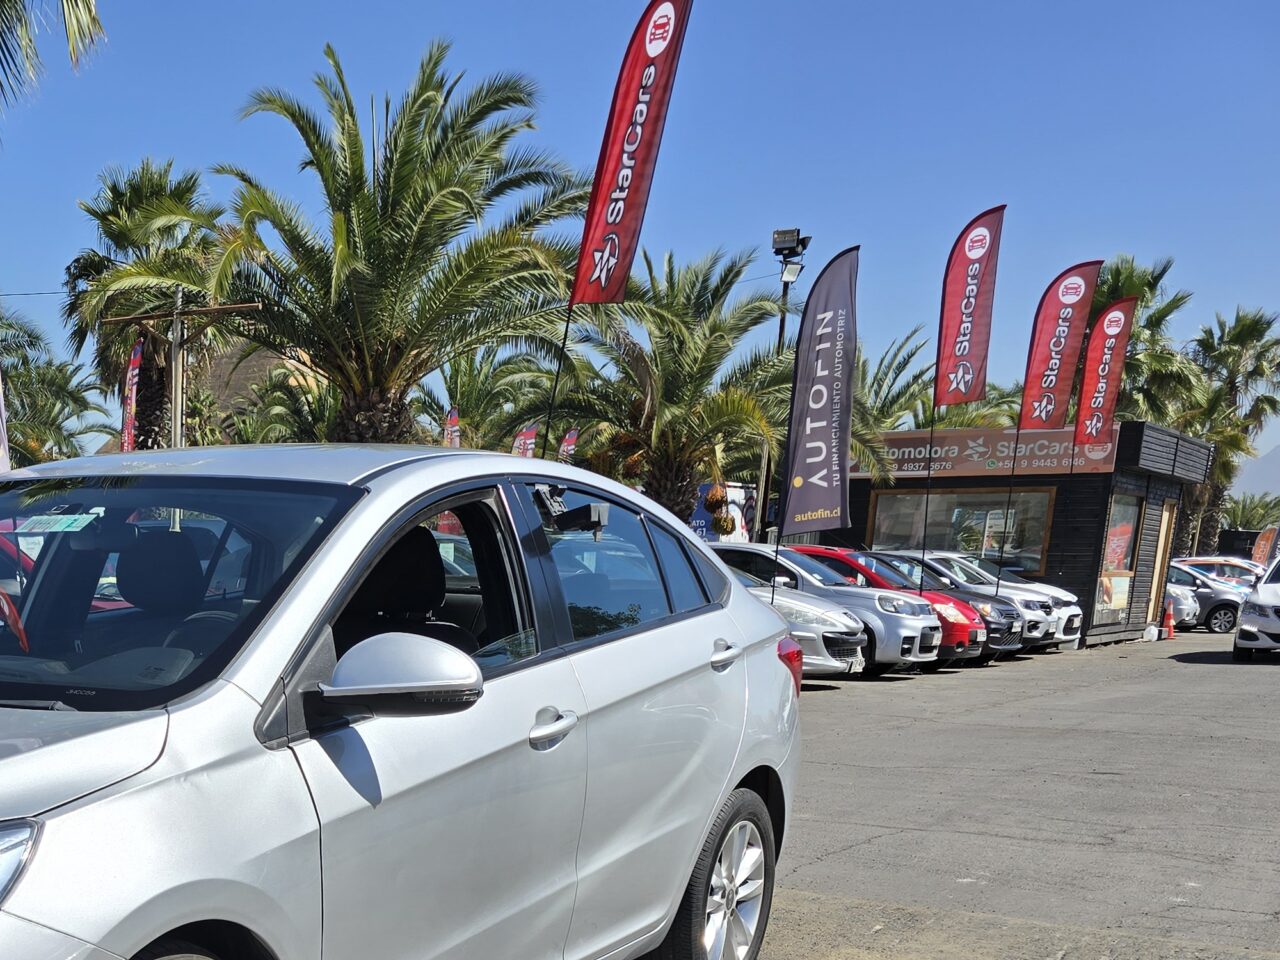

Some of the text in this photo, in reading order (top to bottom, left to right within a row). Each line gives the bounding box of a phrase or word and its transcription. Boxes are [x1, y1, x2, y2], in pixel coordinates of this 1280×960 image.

[607, 63, 656, 224] StarCars
[955, 262, 980, 357] StarCars
[1041, 306, 1073, 389] StarCars
[1091, 337, 1116, 409] StarCars
[831, 308, 847, 488] TU FINANCIAMIENTO AUTOMOTRIZ
[902, 462, 925, 471] 4937
[929, 461, 953, 470] 5676
[996, 439, 1080, 457] StarCars
[1021, 459, 1028, 468] 9
[1032, 459, 1058, 468] 9443
[794, 507, 841, 522] autofin.cl
